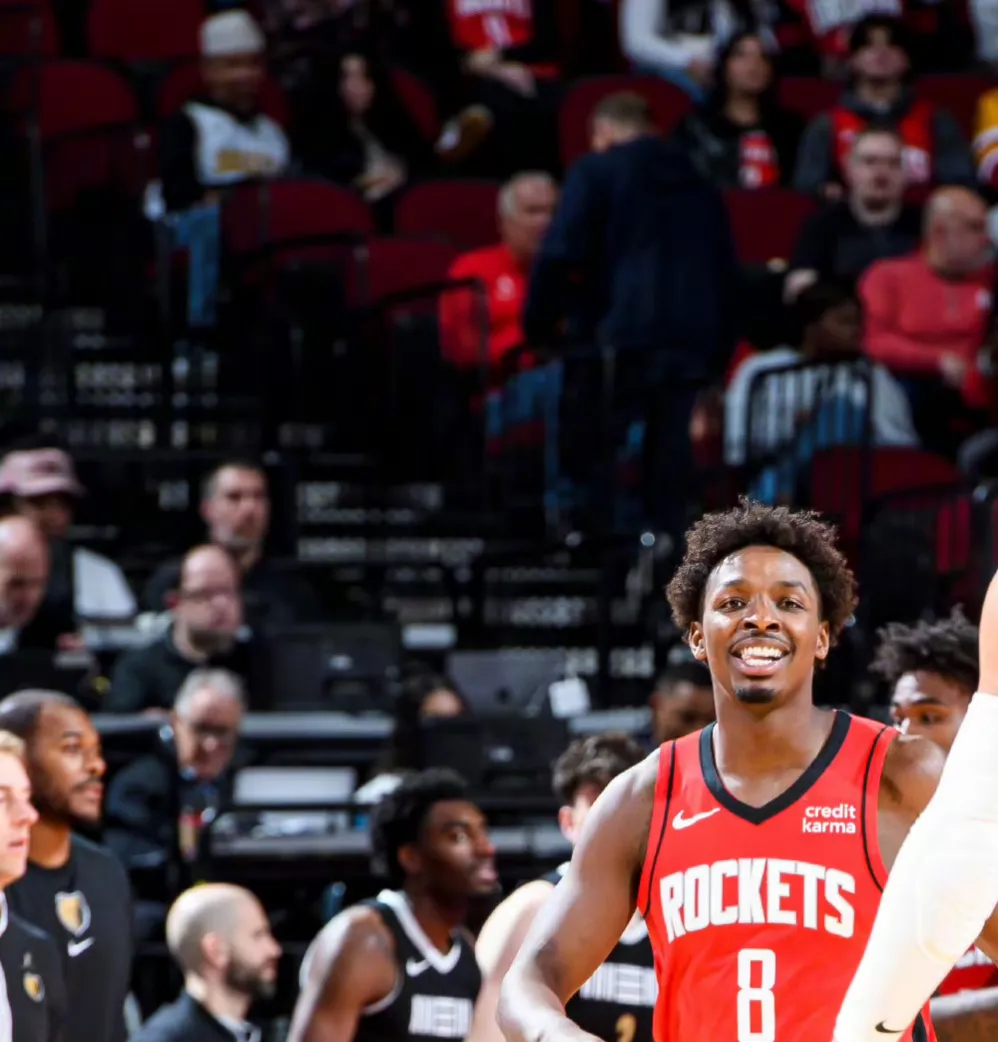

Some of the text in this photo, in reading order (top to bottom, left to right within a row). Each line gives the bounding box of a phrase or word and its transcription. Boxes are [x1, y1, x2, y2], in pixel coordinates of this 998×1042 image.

[805, 803, 857, 819] credit
[802, 816, 857, 834] karma
[659, 857, 856, 944] ROCKETS
